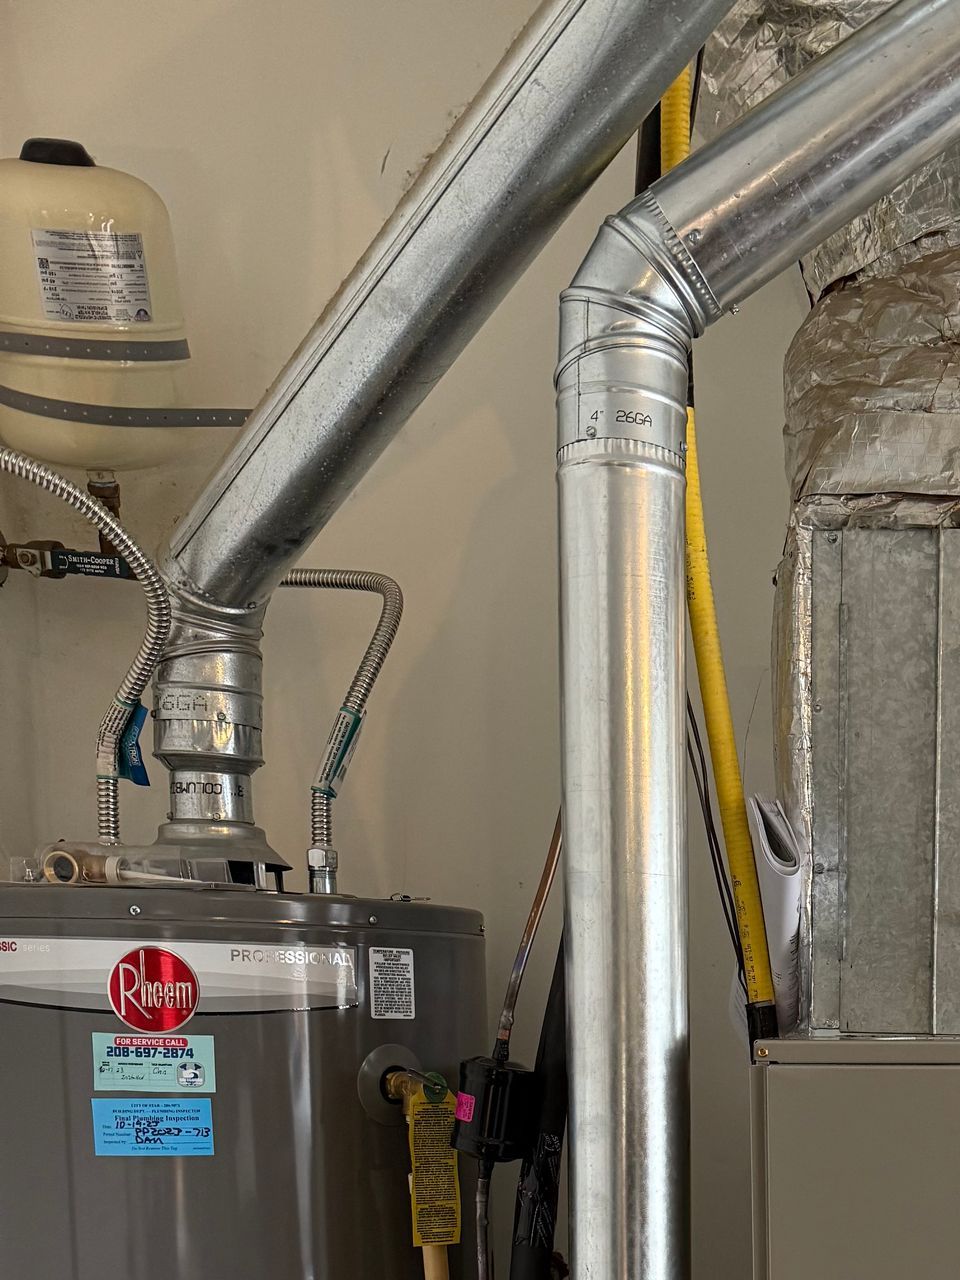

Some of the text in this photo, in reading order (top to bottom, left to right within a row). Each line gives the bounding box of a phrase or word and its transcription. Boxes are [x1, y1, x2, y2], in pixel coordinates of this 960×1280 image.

[615, 410, 652, 428] 26GA
[68, 554, 114, 566] SMITH-COOPER
[23, 942, 50, 952] series
[118, 949, 193, 1020] Rheem
[106, 1046, 194, 1058] 208-697-2874
